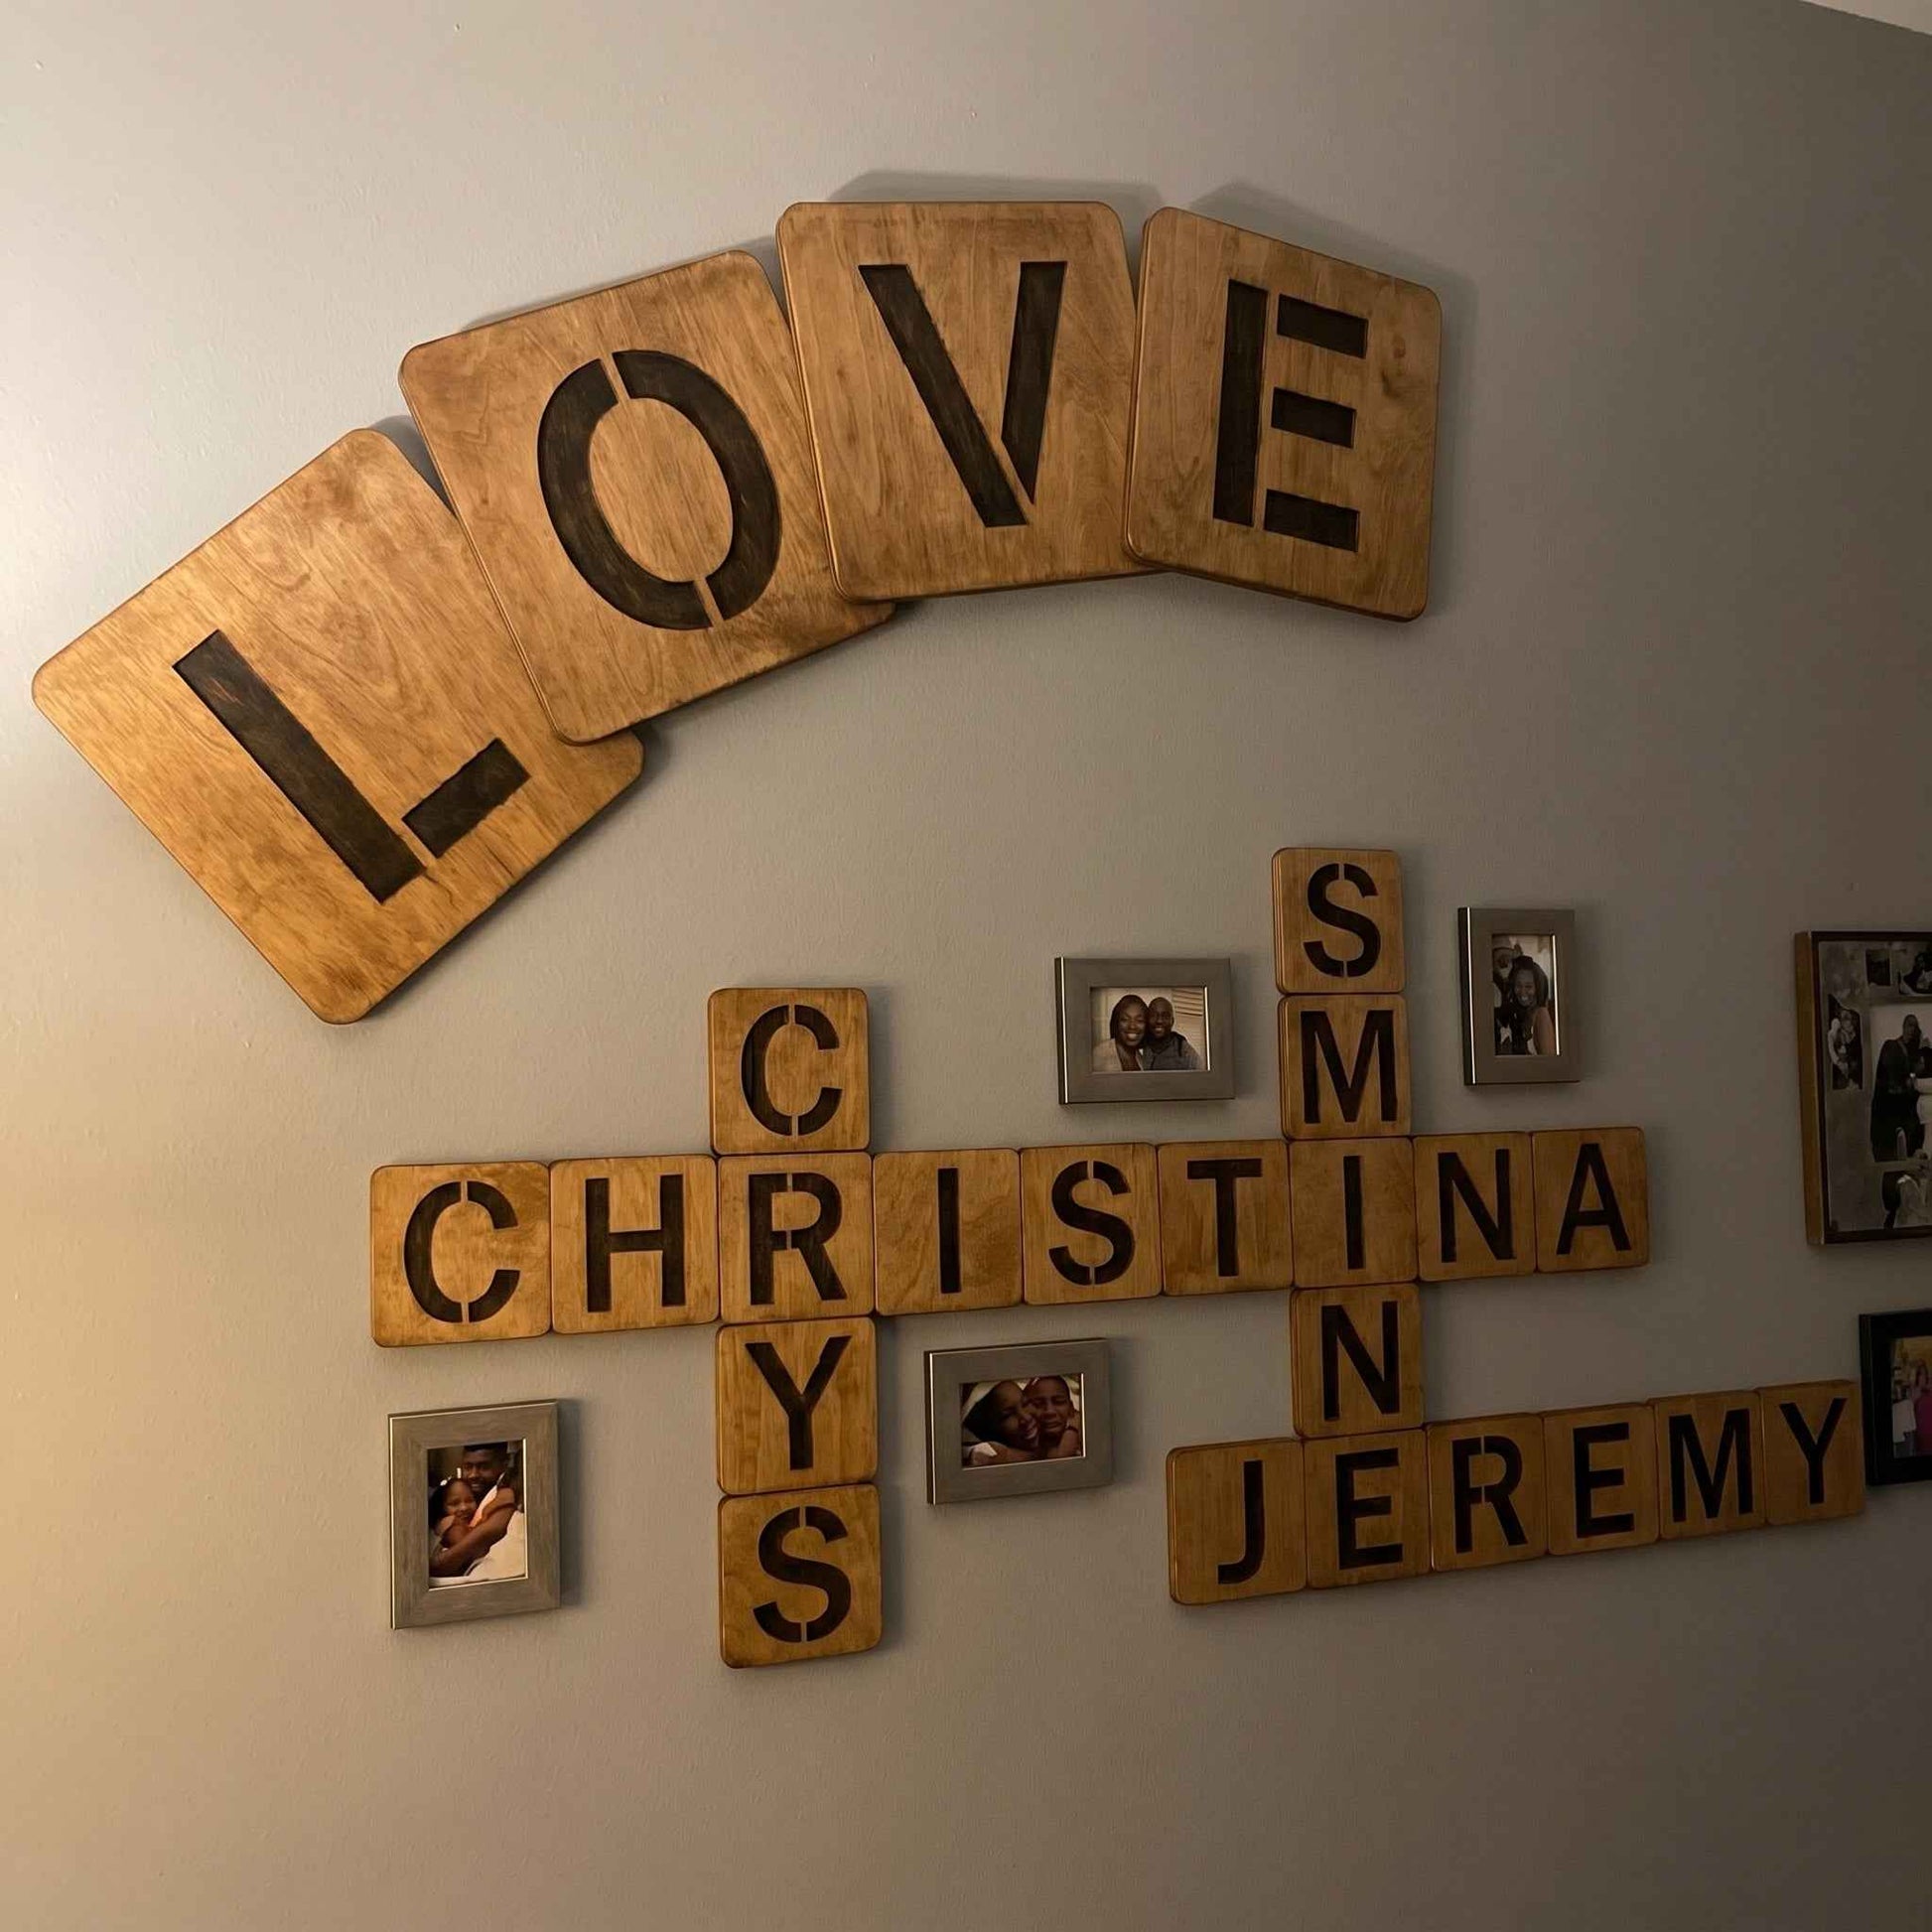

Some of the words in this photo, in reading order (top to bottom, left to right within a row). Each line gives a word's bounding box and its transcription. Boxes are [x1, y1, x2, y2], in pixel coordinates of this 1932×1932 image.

[172, 260, 1369, 904] LOVE
[402, 1142, 1633, 1324] CHRISTINA
[1216, 1397, 1848, 1586] JEREMY
